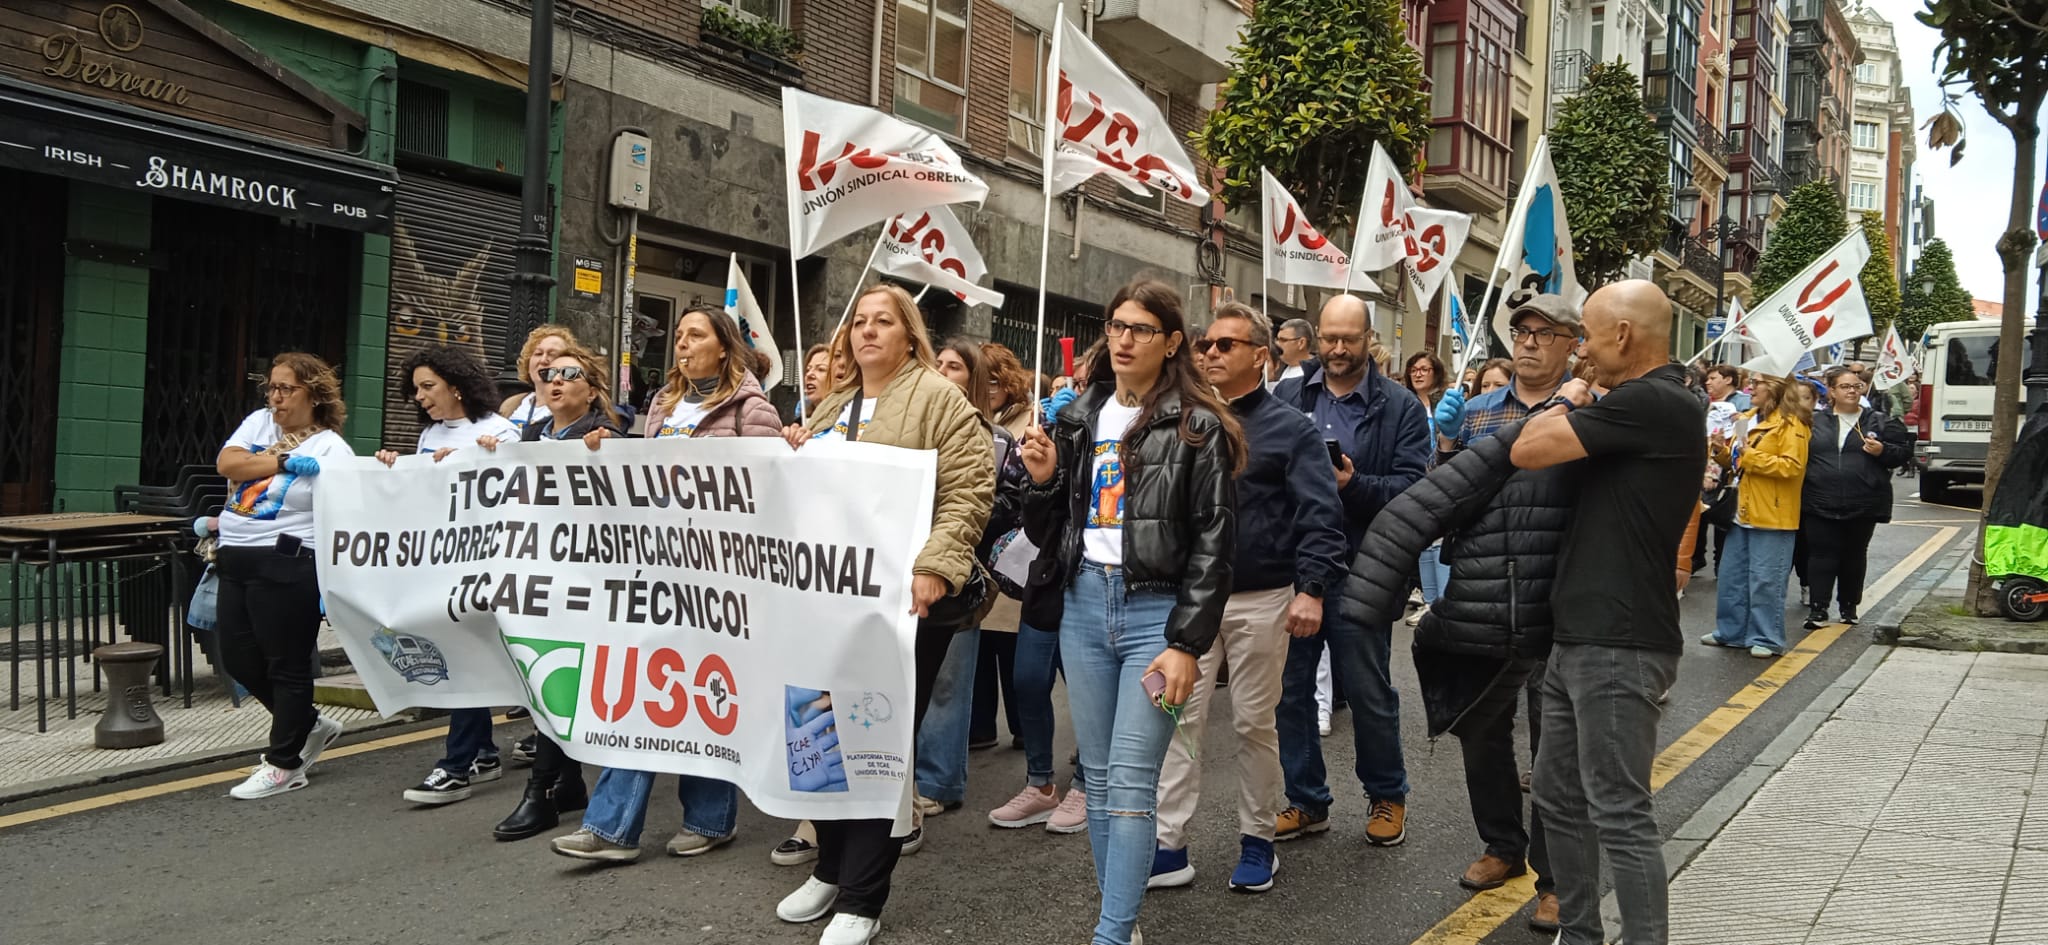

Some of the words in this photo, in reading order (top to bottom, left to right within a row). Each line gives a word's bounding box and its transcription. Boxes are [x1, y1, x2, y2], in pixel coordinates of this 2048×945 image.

[42, 33, 190, 106] Desvan
[45, 146, 101, 168] IRISH
[136, 156, 297, 210] SHAMROCK
[847, 169, 910, 194] SINDICAL
[333, 203, 368, 218] PUB
[1289, 250, 1335, 264] SINDICAL
[449, 465, 559, 522] ¡TCAE
[566, 465, 617, 507] EN
[622, 464, 756, 514] LUCHA!
[332, 530, 390, 567] POR
[396, 530, 426, 567] SU
[430, 520, 538, 565] CORRECTA
[550, 517, 717, 572] CLASIFICACIÓN
[718, 530, 882, 598] PROFESIONAL
[447, 572, 553, 622] ¡TCAE
[604, 569, 750, 640] TÉCNICO!
[590, 645, 739, 736] USO
[585, 730, 630, 749] UNIÓN
[634, 736, 701, 756] SINDICAL
[704, 743, 742, 767] OBRERA
